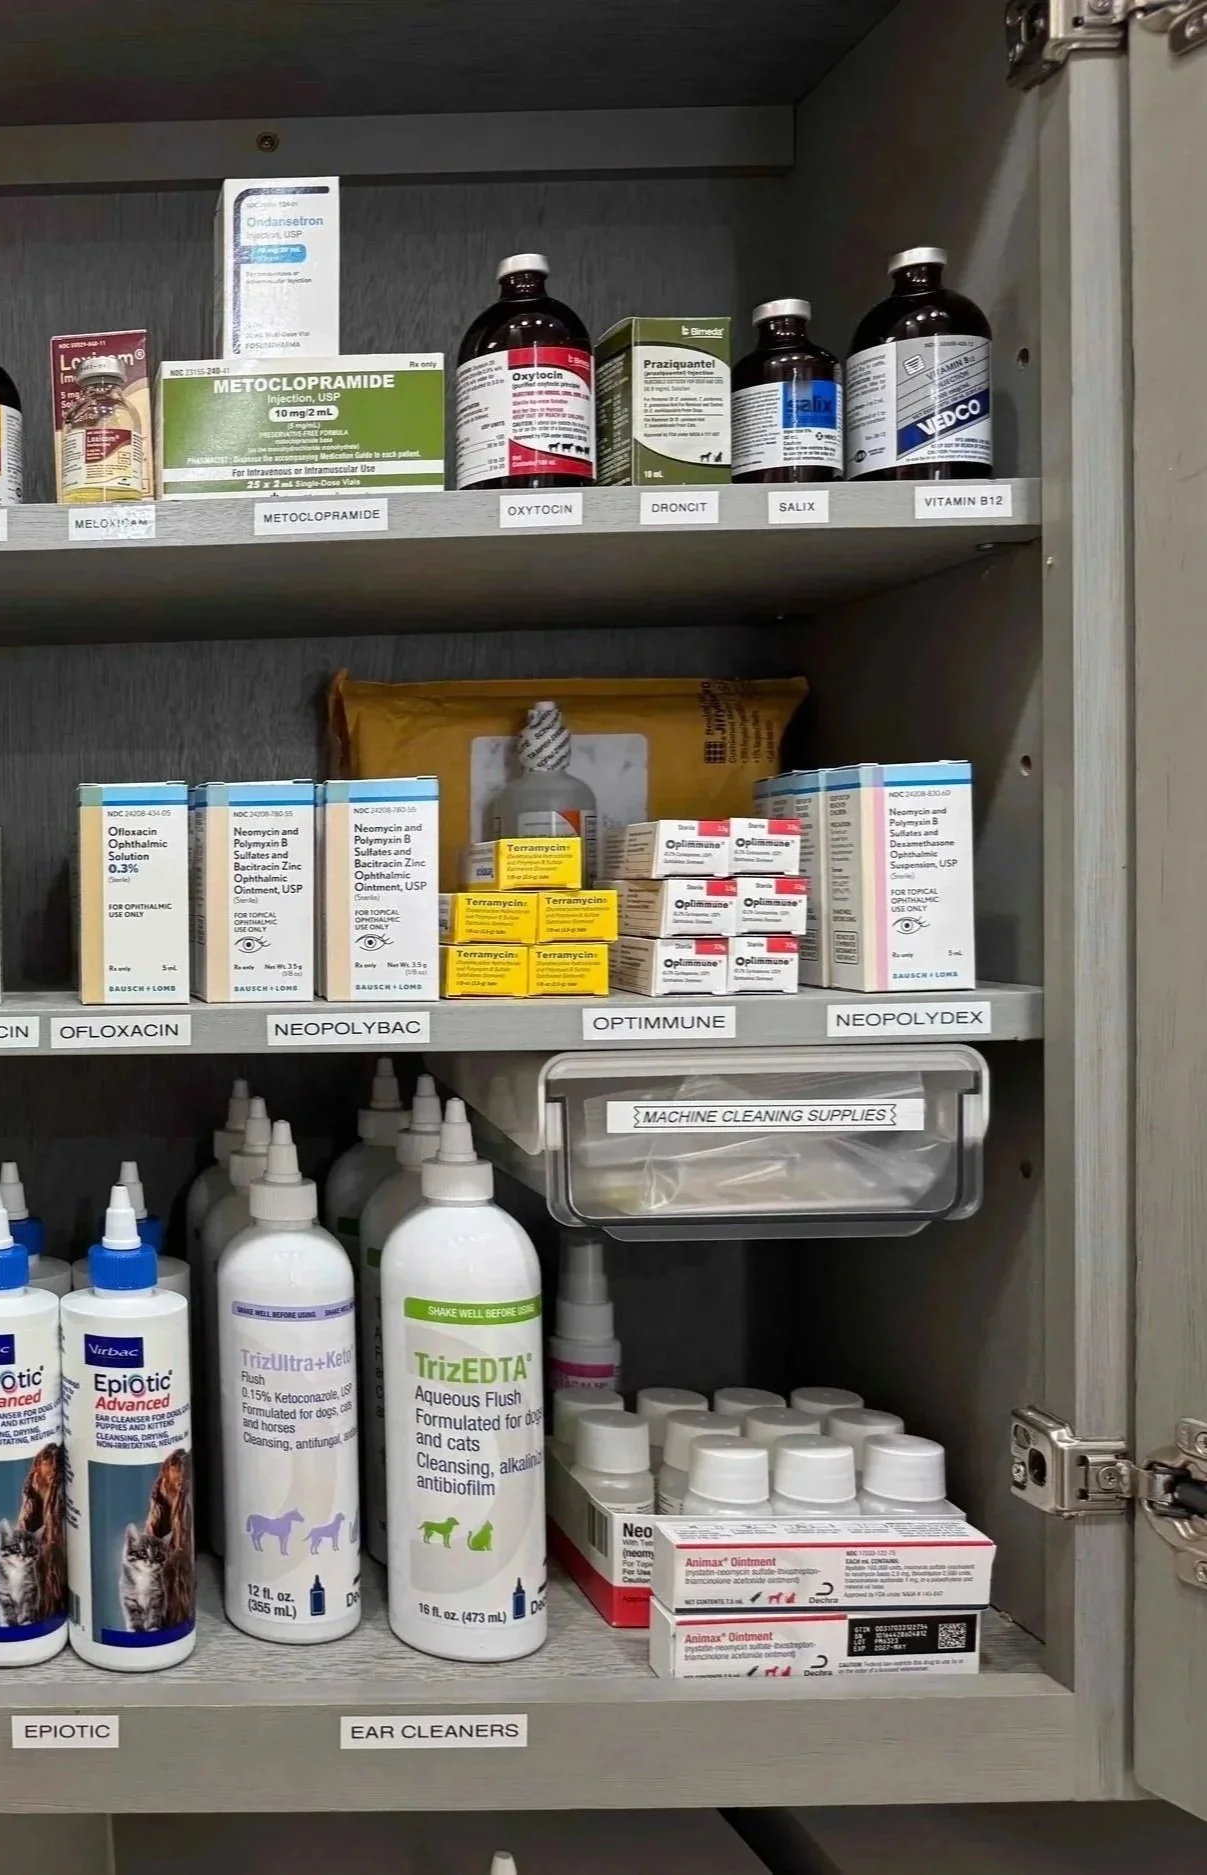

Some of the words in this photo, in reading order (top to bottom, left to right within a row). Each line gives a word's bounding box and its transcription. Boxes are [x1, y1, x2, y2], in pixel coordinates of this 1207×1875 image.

[247, 217, 323, 227] Ondansetron
[644, 359, 715, 370] Praziquantel
[512, 370, 563, 382] Oxytocin
[213, 375, 395, 394] METOCLOPRAMIDE
[267, 394, 315, 404] Injection,
[317, 393, 340, 402] USP
[275, 409, 287, 418] 10
[289, 409, 315, 418] mg/2
[317, 408, 332, 416] mL
[917, 400, 981, 435] VEDCO
[232, 468, 244, 477] For
[246, 467, 292, 476] Intravenous
[304, 465, 358, 475] Intramuscular
[360, 464, 375, 473] Use
[779, 502, 815, 512] SALIX
[925, 496, 976, 507] VITAMIN
[980, 496, 1003, 506] B12
[507, 504, 572, 517] OXYTOCIN
[652, 502, 707, 513] DRONCIT
[264, 509, 380, 523] METOCLOPRAMIDE
[108, 827, 157, 837] Ofloxacin
[234, 827, 279, 838] Neomycin
[281, 827, 299, 836] and
[108, 839, 168, 850] Ophthalmic
[234, 839, 280, 849] Polymyxin
[282, 839, 288, 847] B
[507, 844, 566, 852] Terramycin
[666, 840, 721, 850] Optimmune
[735, 838, 790, 848] Optimmune
[890, 839, 954, 848] Dexamethasone
[108, 852, 149, 861] Solution
[234, 851, 270, 859] Sulfates
[272, 851, 288, 859] and
[890, 850, 938, 859] Ophthalmic
[108, 864, 139, 874] 0.3%
[234, 862, 280, 871] Bacitracin
[282, 862, 302, 871] Zinc
[891, 860, 937, 870] Suspension,
[939, 859, 958, 868] USP
[234, 874, 288, 883] Ophthalmic
[234, 885, 280, 895] Ointment,
[282, 885, 303, 893] USP
[466, 899, 523, 907] Terramycin
[546, 897, 602, 905] Terramycin
[675, 900, 728, 910] Optimmune
[744, 898, 798, 908] Optimmune
[456, 950, 514, 959] Terramycin
[664, 958, 717, 969] Optimmune
[735, 957, 789, 967] Optimmune
[593, 1016, 725, 1030] OPTIMMUNE
[836, 1011, 983, 1027] NEOPOLYDEX
[59, 1023, 179, 1039] OFLOXACIN
[275, 1021, 421, 1036] NEOPOLYBAC
[643, 1110, 717, 1124] MACHINE
[721, 1109, 803, 1123] CLEANING
[807, 1108, 887, 1122] SUPPLIES
[88, 1343, 139, 1357] Virbac
[242, 1371, 265, 1387] Flush
[95, 1393, 170, 1411] Advanced
[415, 1385, 480, 1408] Aqueous
[485, 1388, 521, 1407] Flush
[415, 1408, 501, 1431] Formulated
[505, 1411, 523, 1430] for
[416, 1430, 441, 1449] and
[447, 1433, 481, 1452] cats
[417, 1452, 494, 1479] Cleansing,
[417, 1475, 495, 1497] antibiofilm
[731, 1557, 776, 1567] Ointment
[728, 1632, 773, 1641] Ointment
[24, 1724, 110, 1739] EPIOTIC
[351, 1726, 394, 1739] EAR
[401, 1724, 519, 1738] CLEANERS
